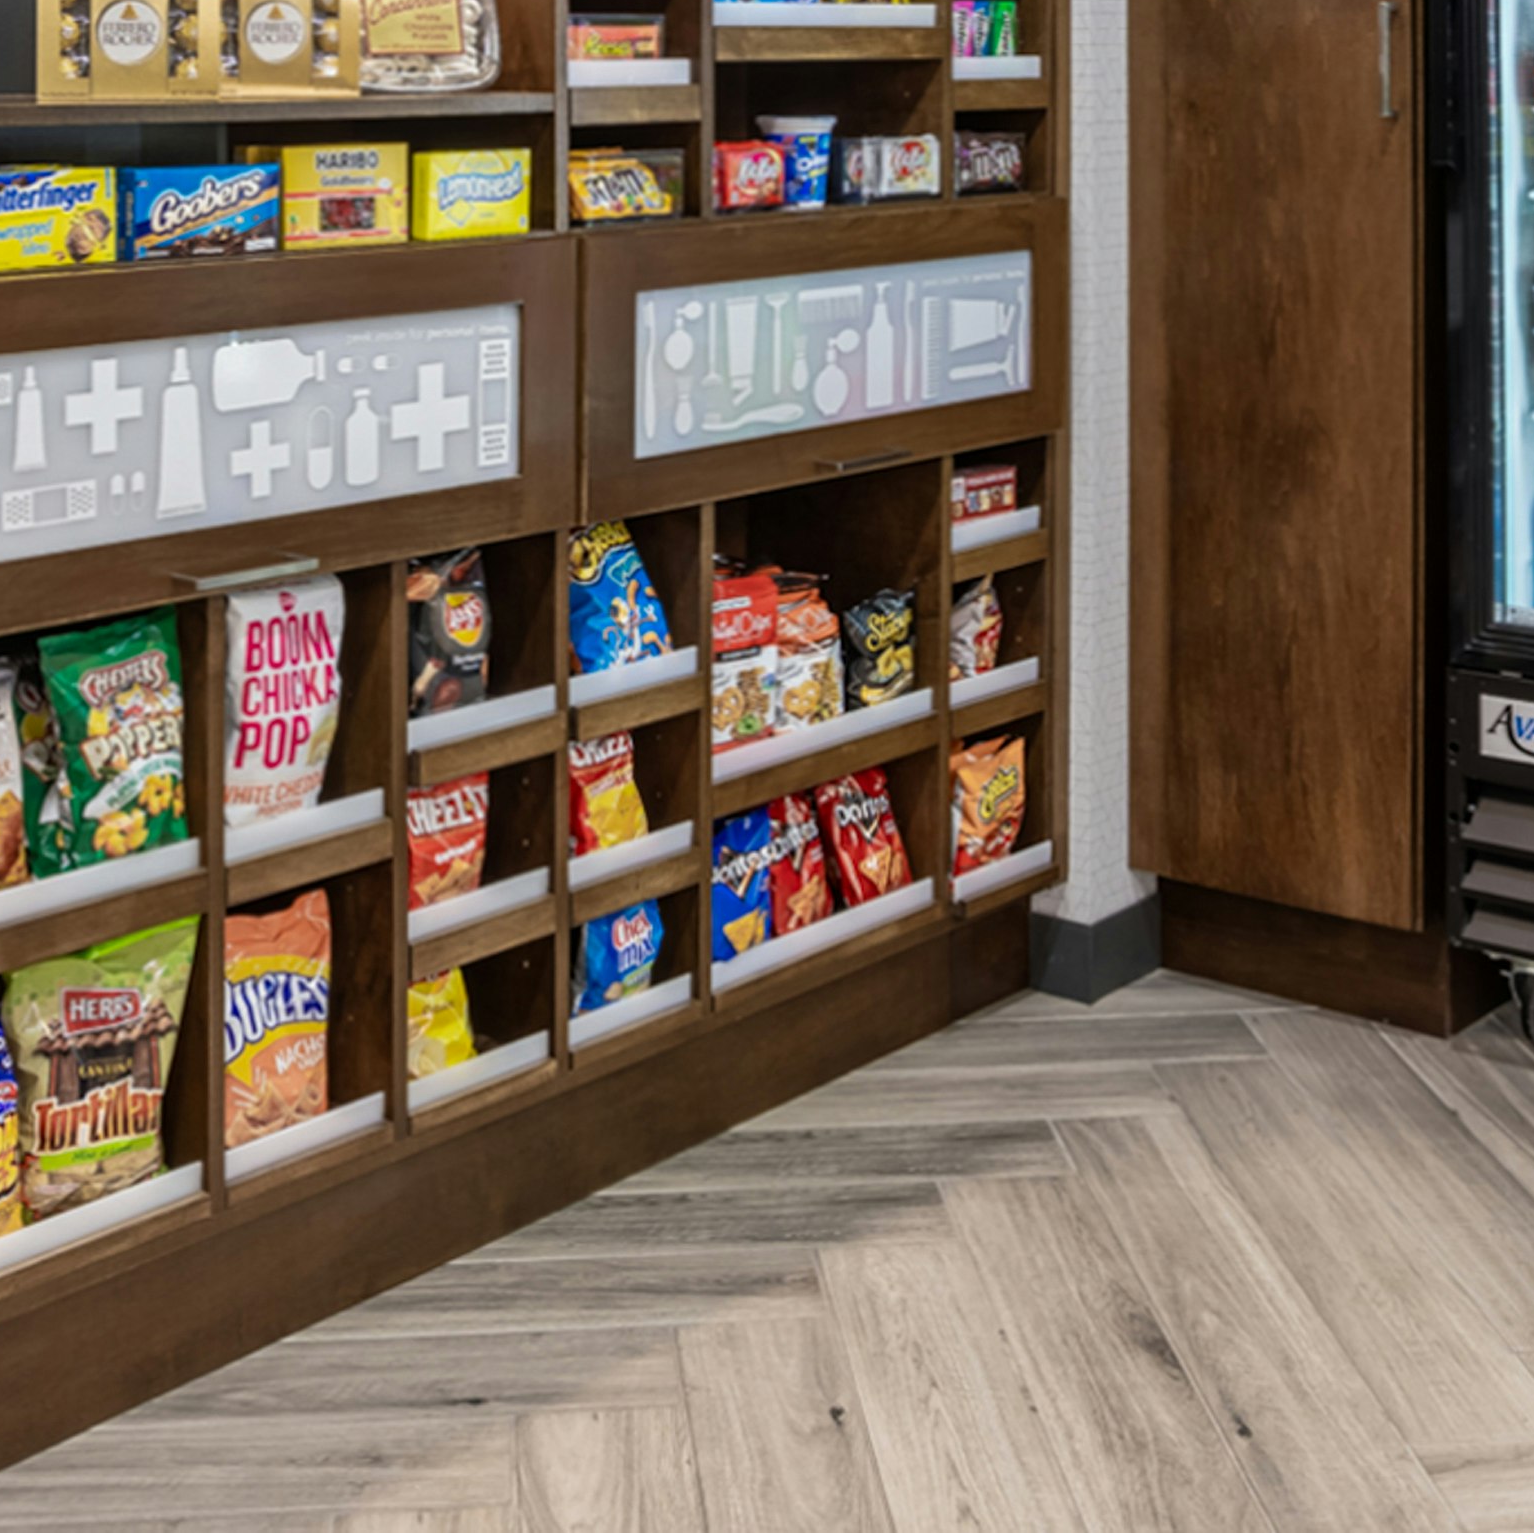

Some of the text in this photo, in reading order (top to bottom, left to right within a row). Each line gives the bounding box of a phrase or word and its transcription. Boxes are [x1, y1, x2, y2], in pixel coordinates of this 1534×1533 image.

[102, 21, 156, 34] FERRERO
[102, 33, 156, 46] ROCHER
[249, 20, 301, 33] FERRERO
[249, 32, 301, 44] ROCHER
[316, 150, 379, 169] HARIBO
[149, 168, 265, 234] Goobers
[244, 611, 336, 674] BOOM
[241, 663, 337, 717] CHICKA
[234, 716, 311, 769] POP
[224, 784, 273, 804] WHITE
[835, 797, 890, 827] Doritos
[612, 909, 653, 950] Chex
[69, 994, 135, 1021] HERR'S
